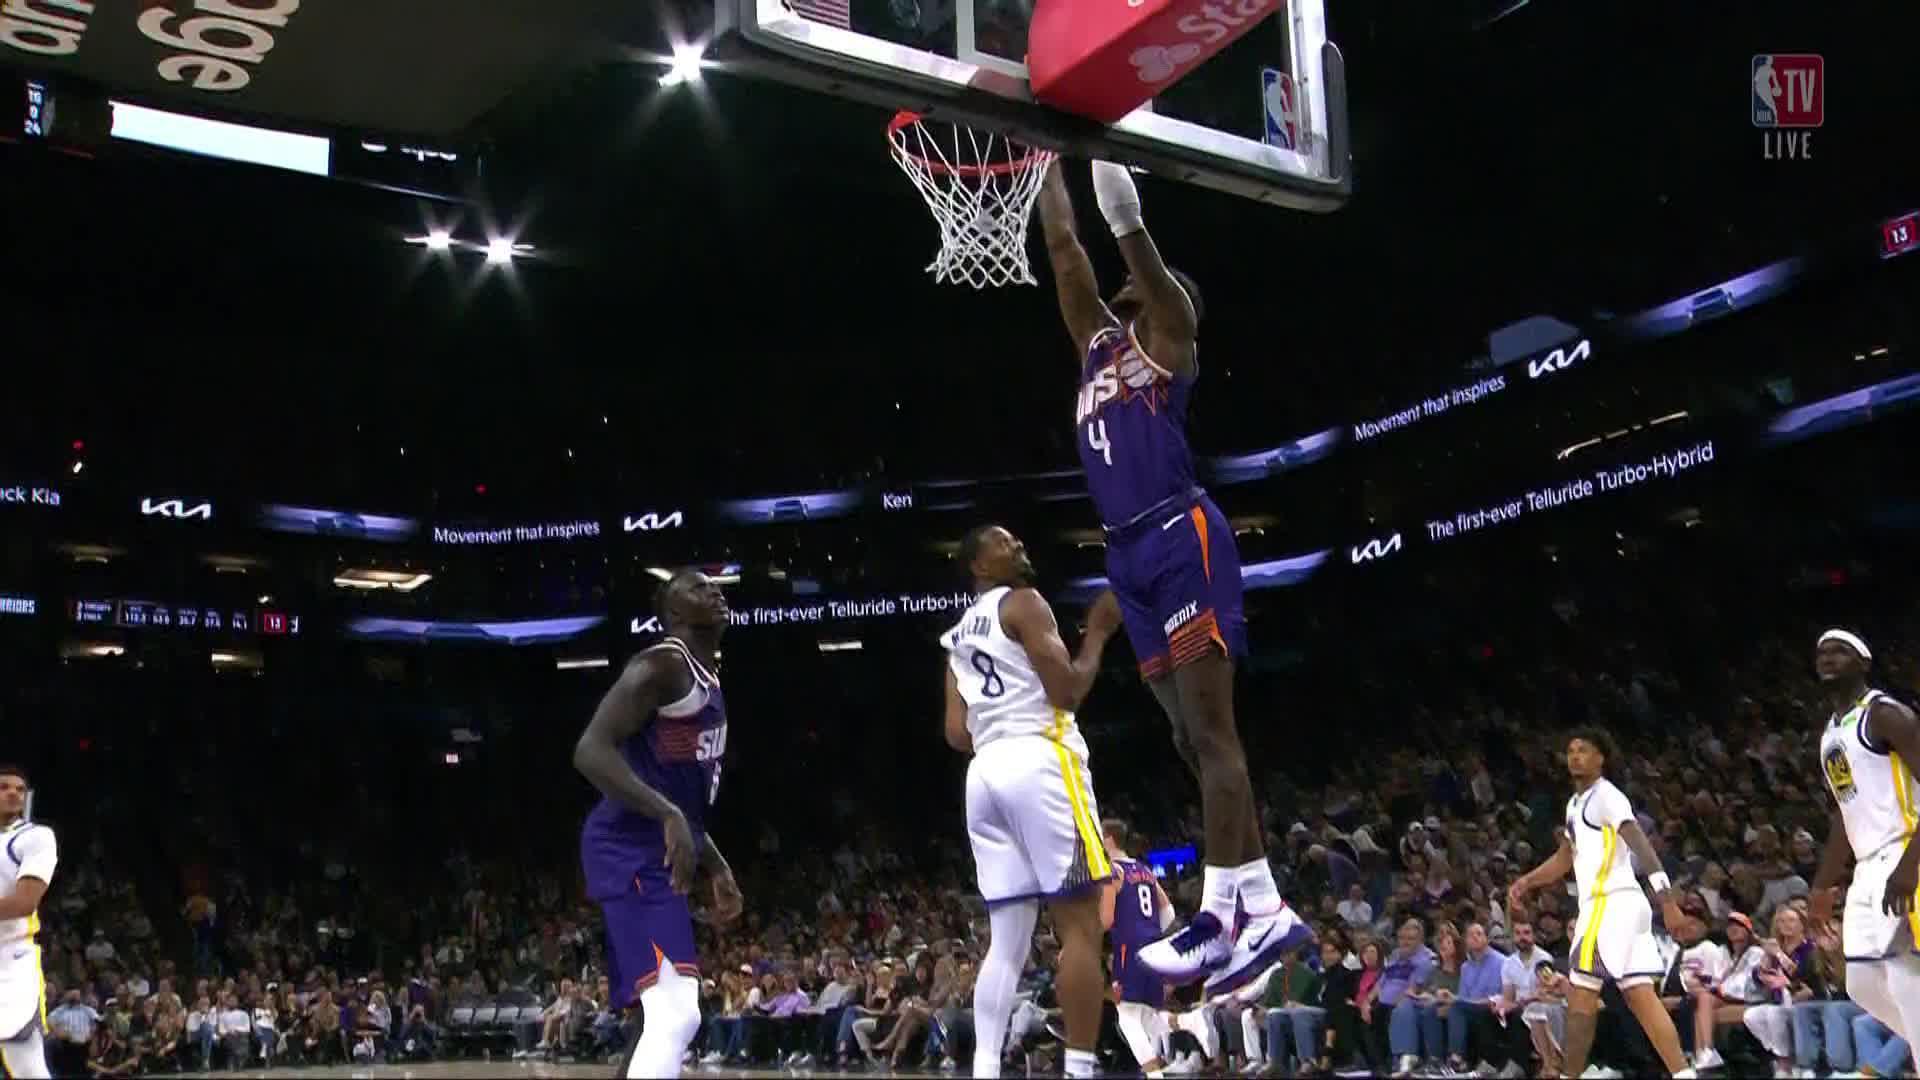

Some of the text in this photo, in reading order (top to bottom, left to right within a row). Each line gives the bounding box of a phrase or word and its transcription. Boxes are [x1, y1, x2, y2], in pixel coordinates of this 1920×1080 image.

[1355, 375, 1506, 442] Movement that inspires
[1088, 418, 1113, 467] 4
[32, 486, 61, 506] Kia
[883, 494, 912, 510] Ken
[1426, 440, 1714, 541] The first-ever Telluride Turbo-Hybrid
[434, 519, 600, 544] Movement that inspires
[753, 604, 824, 624] first-ever
[828, 600, 896, 619] Telluride
[970, 648, 1005, 698] 8
[1136, 883, 1153, 918] 8
